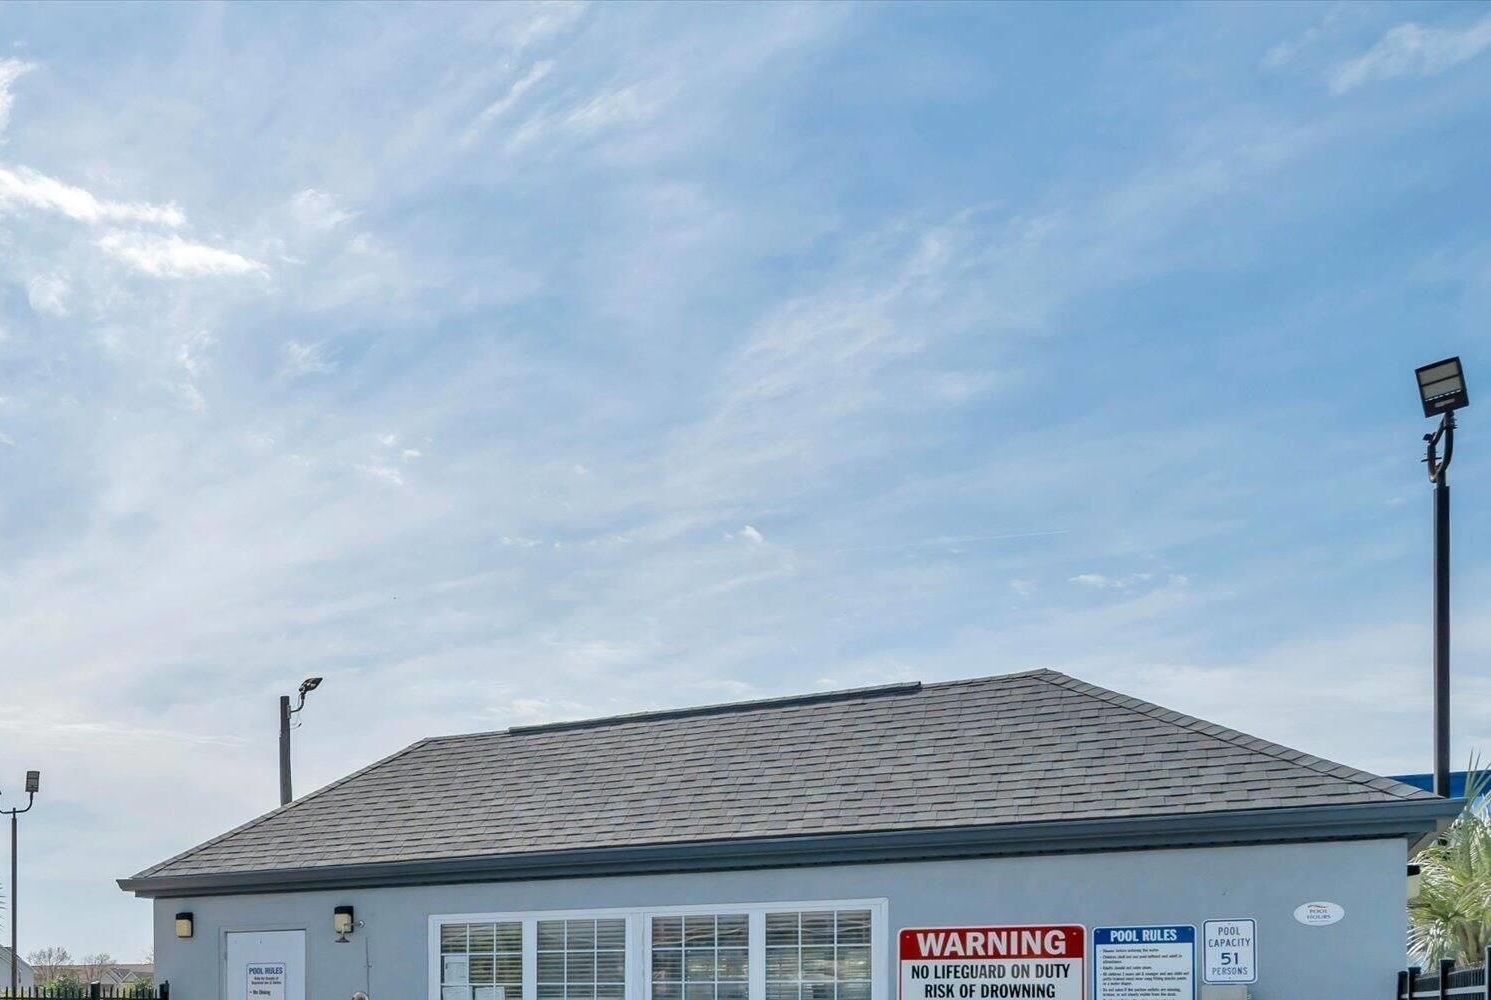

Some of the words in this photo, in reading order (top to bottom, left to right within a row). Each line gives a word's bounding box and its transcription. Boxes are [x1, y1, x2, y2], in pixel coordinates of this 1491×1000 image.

[1110, 930, 1139, 943] POOL
[1142, 929, 1178, 942] RULES
[1218, 926, 1240, 936] POOL
[916, 929, 1067, 957] WARNING
[1208, 938, 1251, 948] CAPACITY
[1220, 952, 1239, 966] 51
[249, 967, 264, 975] POOL
[264, 967, 284, 975] RULES
[911, 965, 930, 979] NO
[934, 964, 1006, 979] LIFEGUARD
[1011, 964, 1030, 979] ON
[1035, 964, 1071, 978] DUTY
[1212, 967, 1248, 976] PERSONS
[925, 984, 955, 998] RISK
[960, 984, 976, 998] OF
[981, 984, 1056, 998] DROWNING
